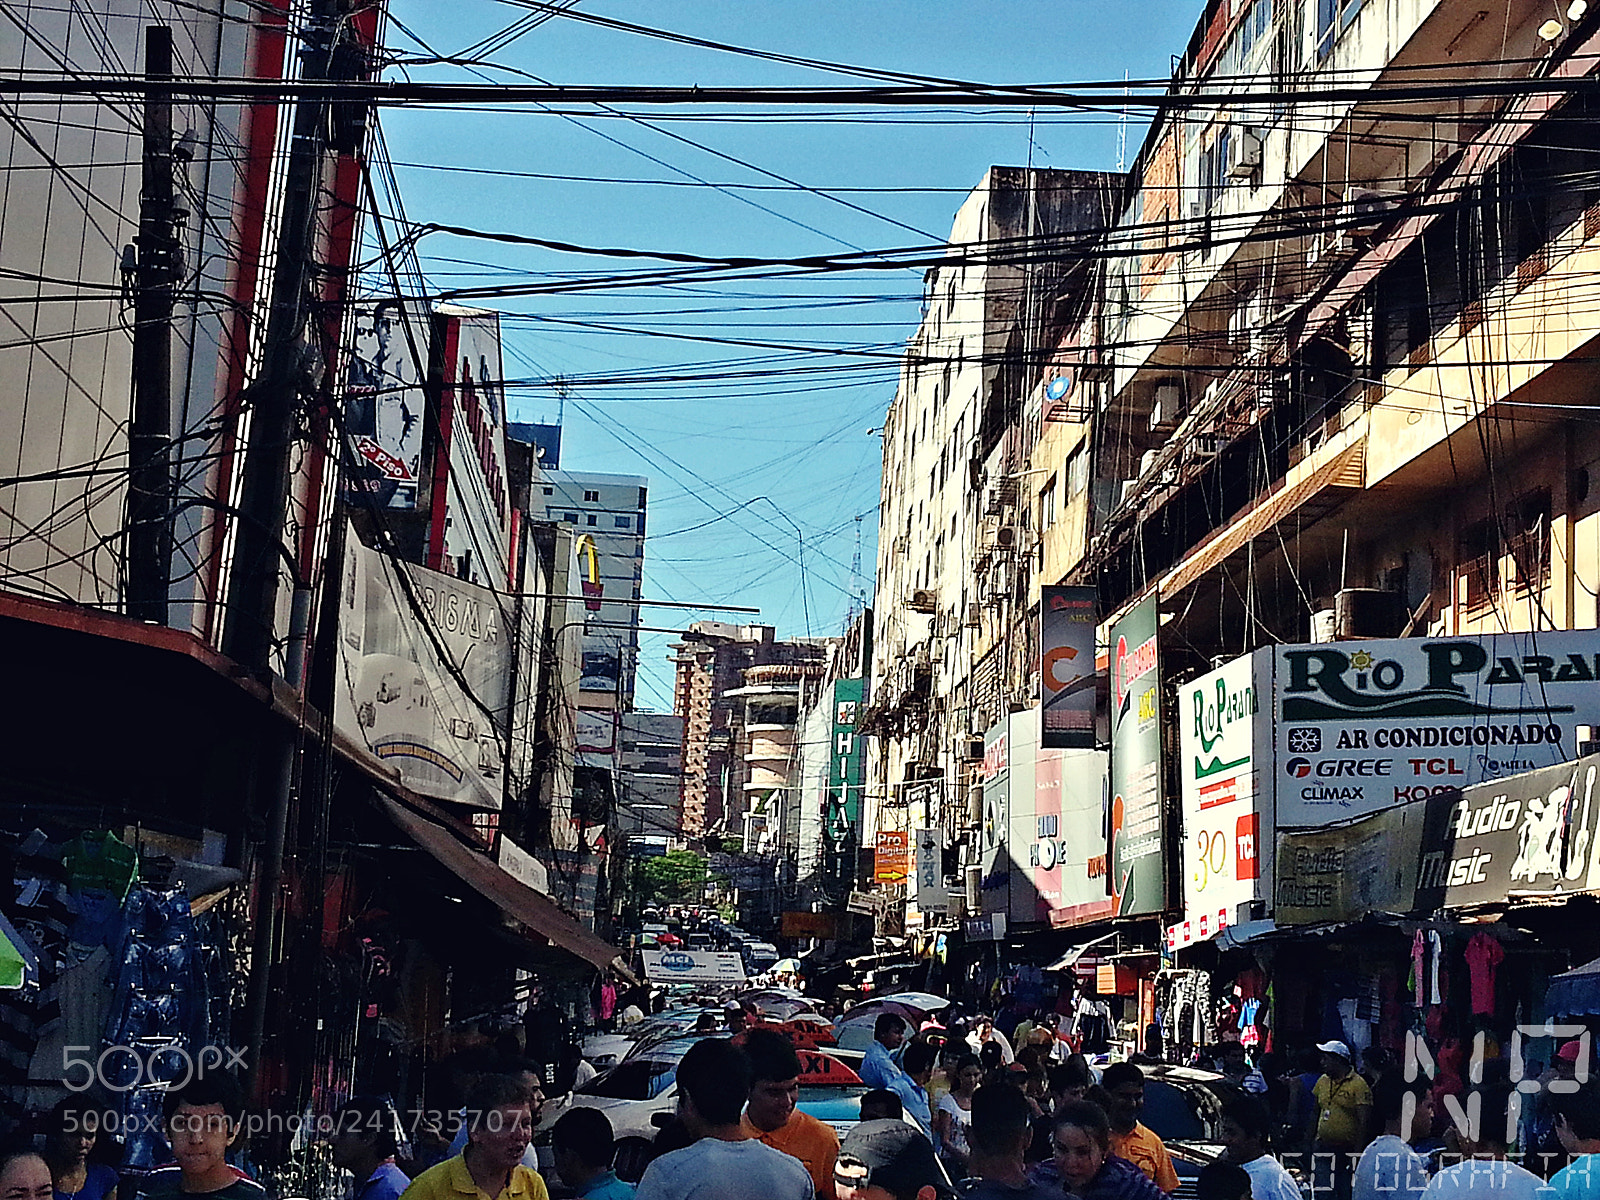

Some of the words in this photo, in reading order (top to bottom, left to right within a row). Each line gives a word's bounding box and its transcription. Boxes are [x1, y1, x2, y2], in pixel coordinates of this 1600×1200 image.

[375, 452, 404, 477] Piso
[1336, 729, 1369, 750] AR
[1374, 724, 1562, 749] CONDICIONADO
[1316, 758, 1394, 777] GREE
[1408, 758, 1464, 776] TCL
[1301, 786, 1364, 801] CLIMAX
[1444, 795, 1522, 840] Audio
[877, 833, 902, 847] Pro
[1417, 847, 1492, 891] Music
